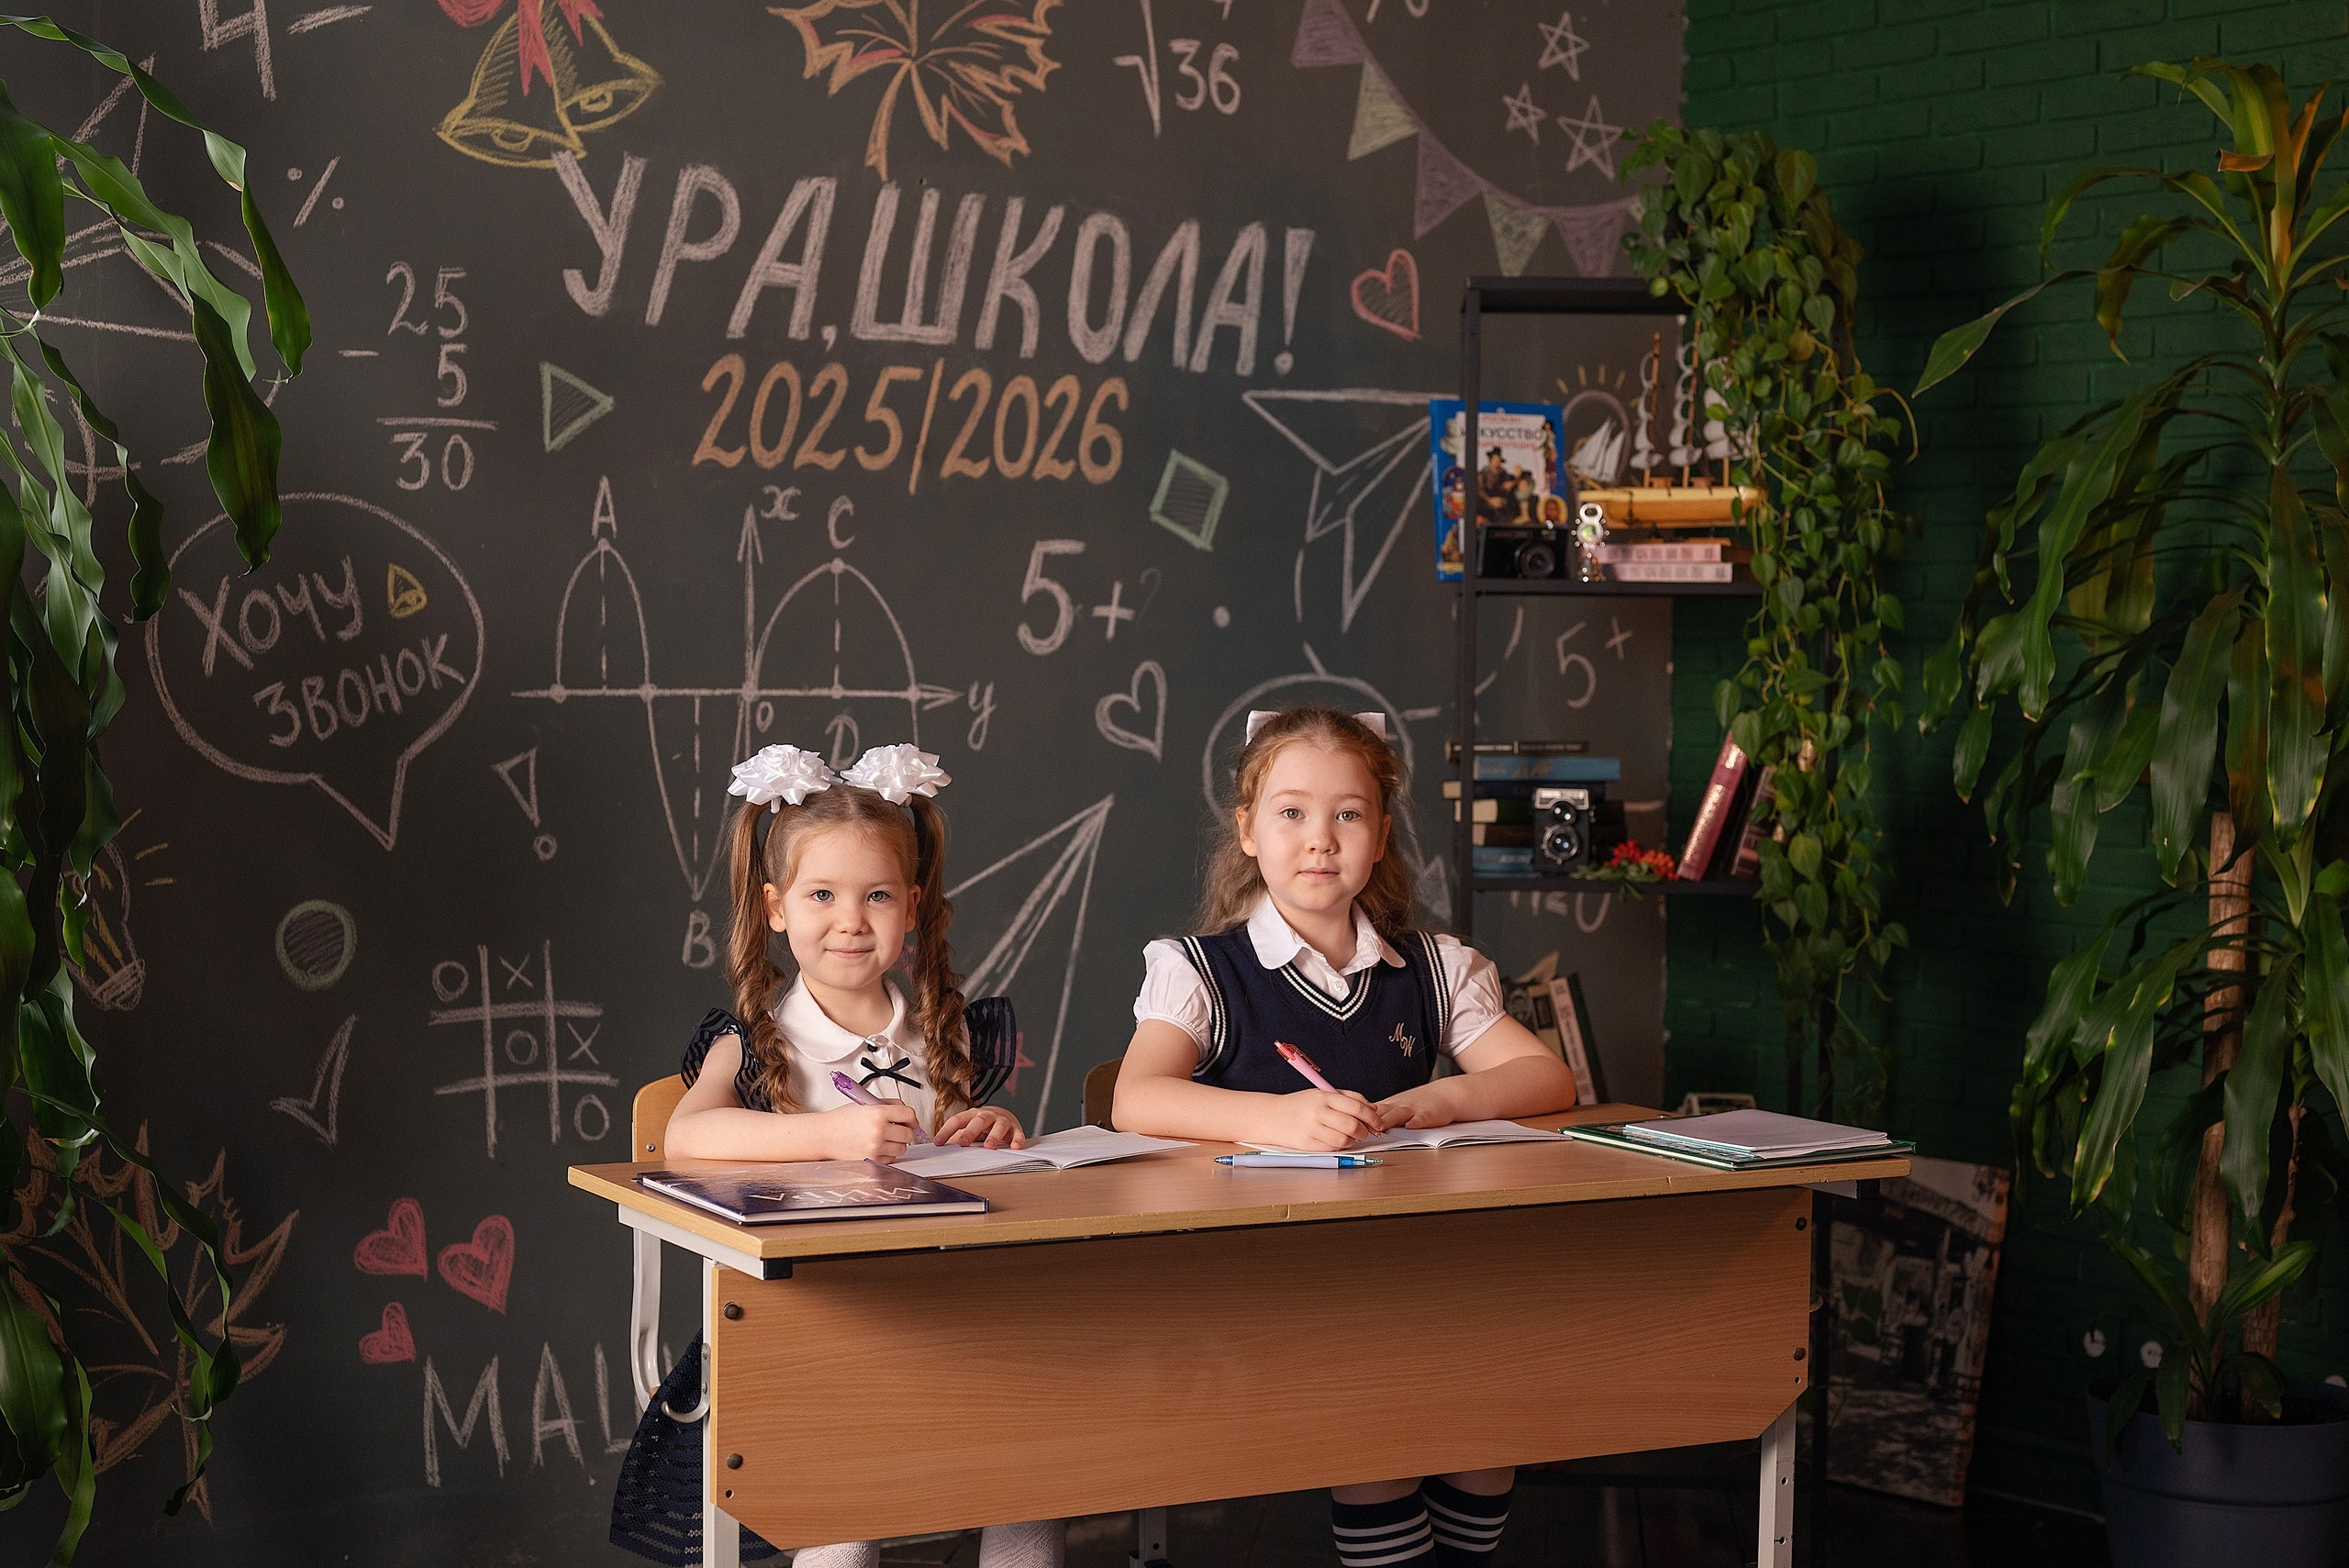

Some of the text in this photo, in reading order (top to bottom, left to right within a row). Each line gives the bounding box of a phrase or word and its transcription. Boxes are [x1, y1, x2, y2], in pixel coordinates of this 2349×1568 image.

[385, 261, 469, 340] 25
[392, 432, 474, 492] 30
[692, 353, 1130, 495] 2025/2026
[253, 633, 466, 747] ЗВОНОК
[682, 909, 717, 969] B
